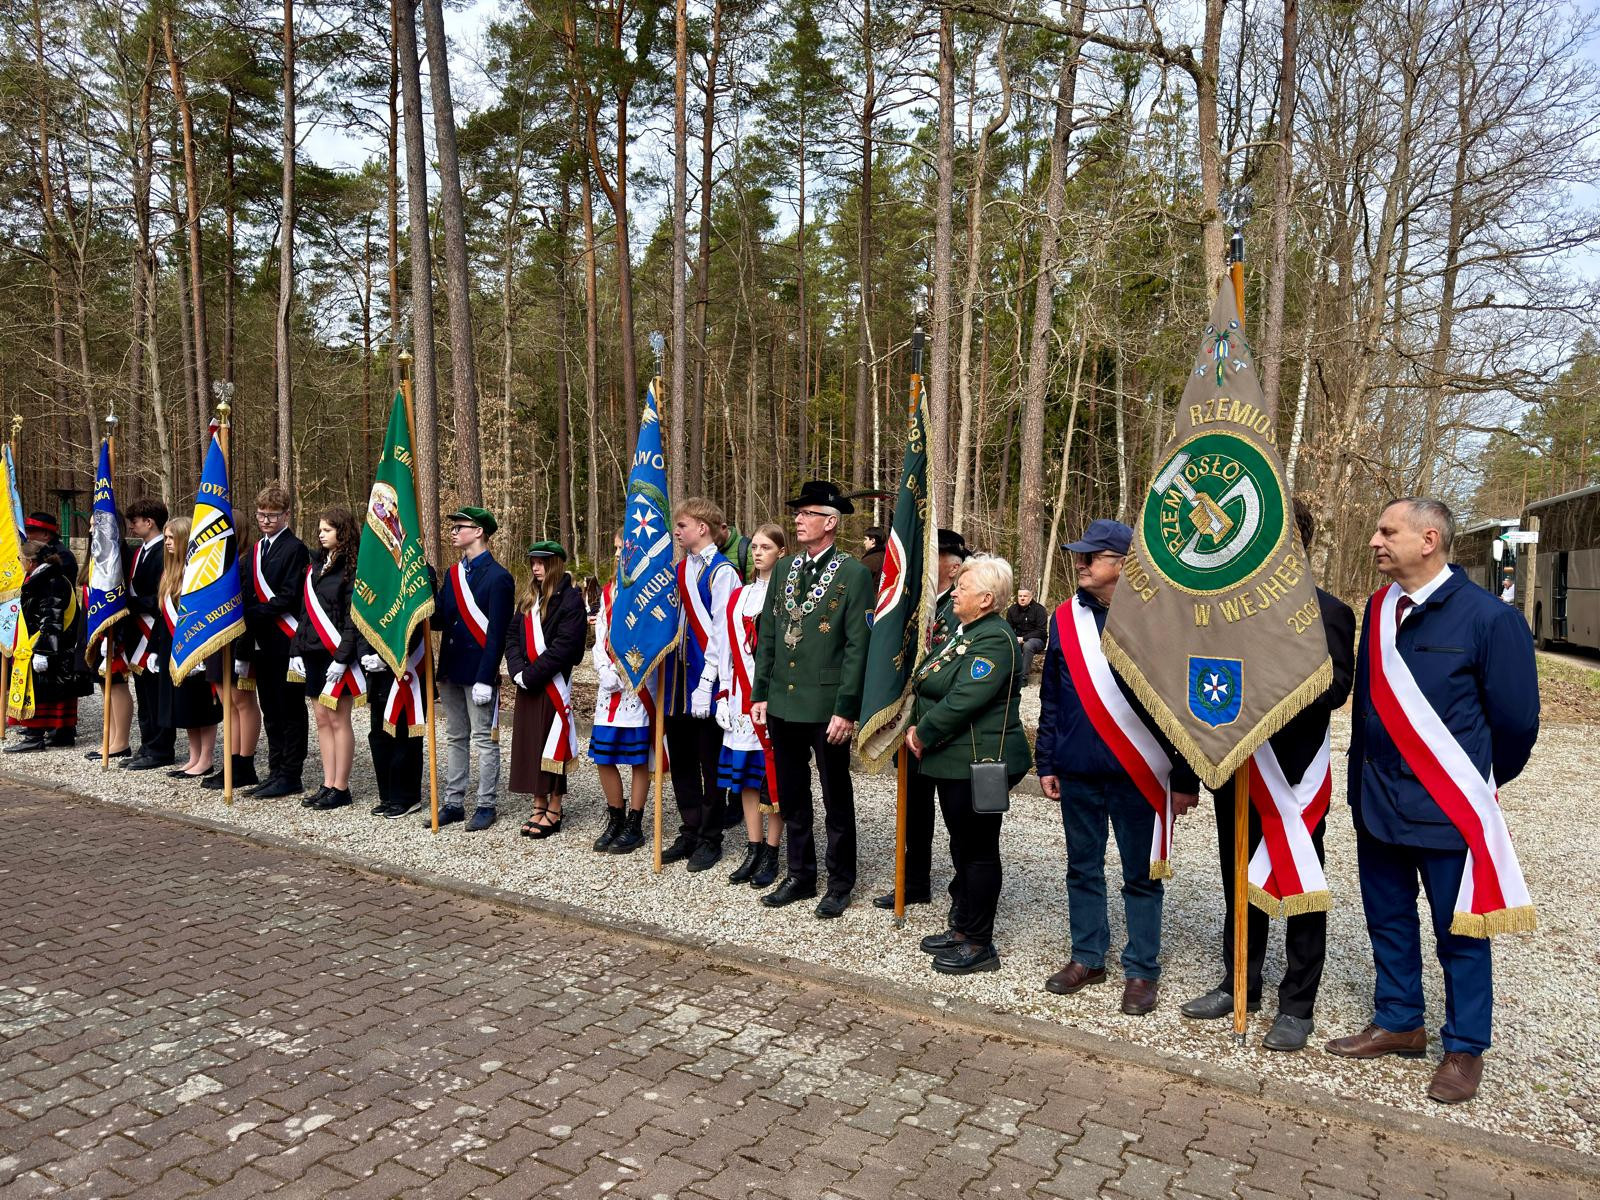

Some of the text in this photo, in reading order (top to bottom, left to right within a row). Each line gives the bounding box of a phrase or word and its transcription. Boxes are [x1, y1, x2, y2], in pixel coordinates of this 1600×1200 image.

[406, 575, 428, 598] 2012
[634, 567, 675, 612] JAKUBA
[650, 605, 668, 622] W
[1194, 604, 1211, 628] W
[183, 621, 207, 643] JANA
